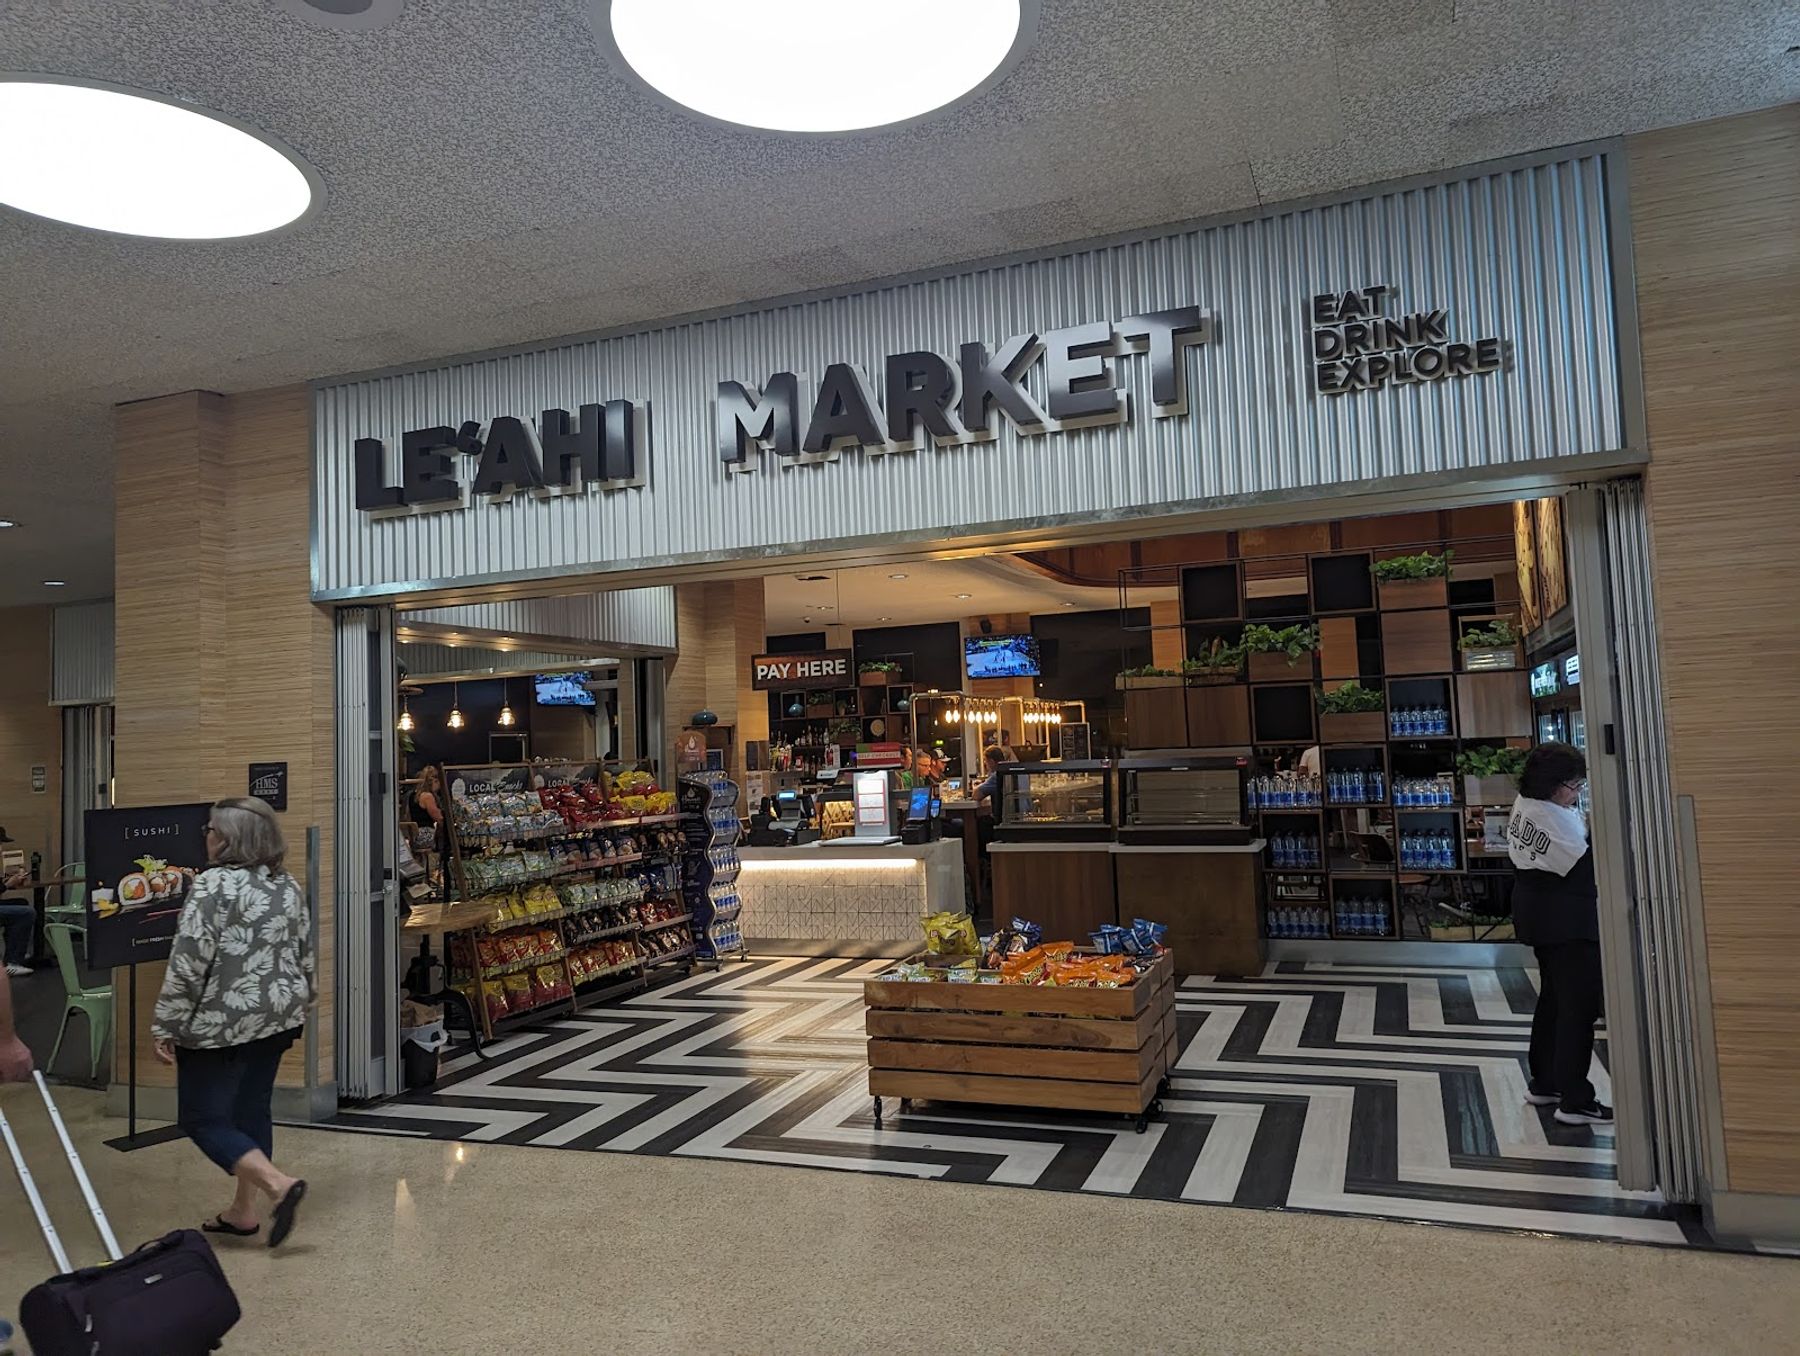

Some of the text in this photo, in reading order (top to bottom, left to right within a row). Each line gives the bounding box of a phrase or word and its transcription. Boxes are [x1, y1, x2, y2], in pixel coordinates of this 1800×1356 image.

[1313, 285, 1386, 323] EAT
[1315, 310, 1446, 361] DRINK
[1316, 336, 1500, 391] EXPLORE
[717, 305, 1203, 464] MARKET
[757, 659, 846, 680] PAY HERE
[255, 777, 278, 789] HMS
[469, 783, 496, 793] LOCAL
[133, 826, 170, 837] SUSHI
